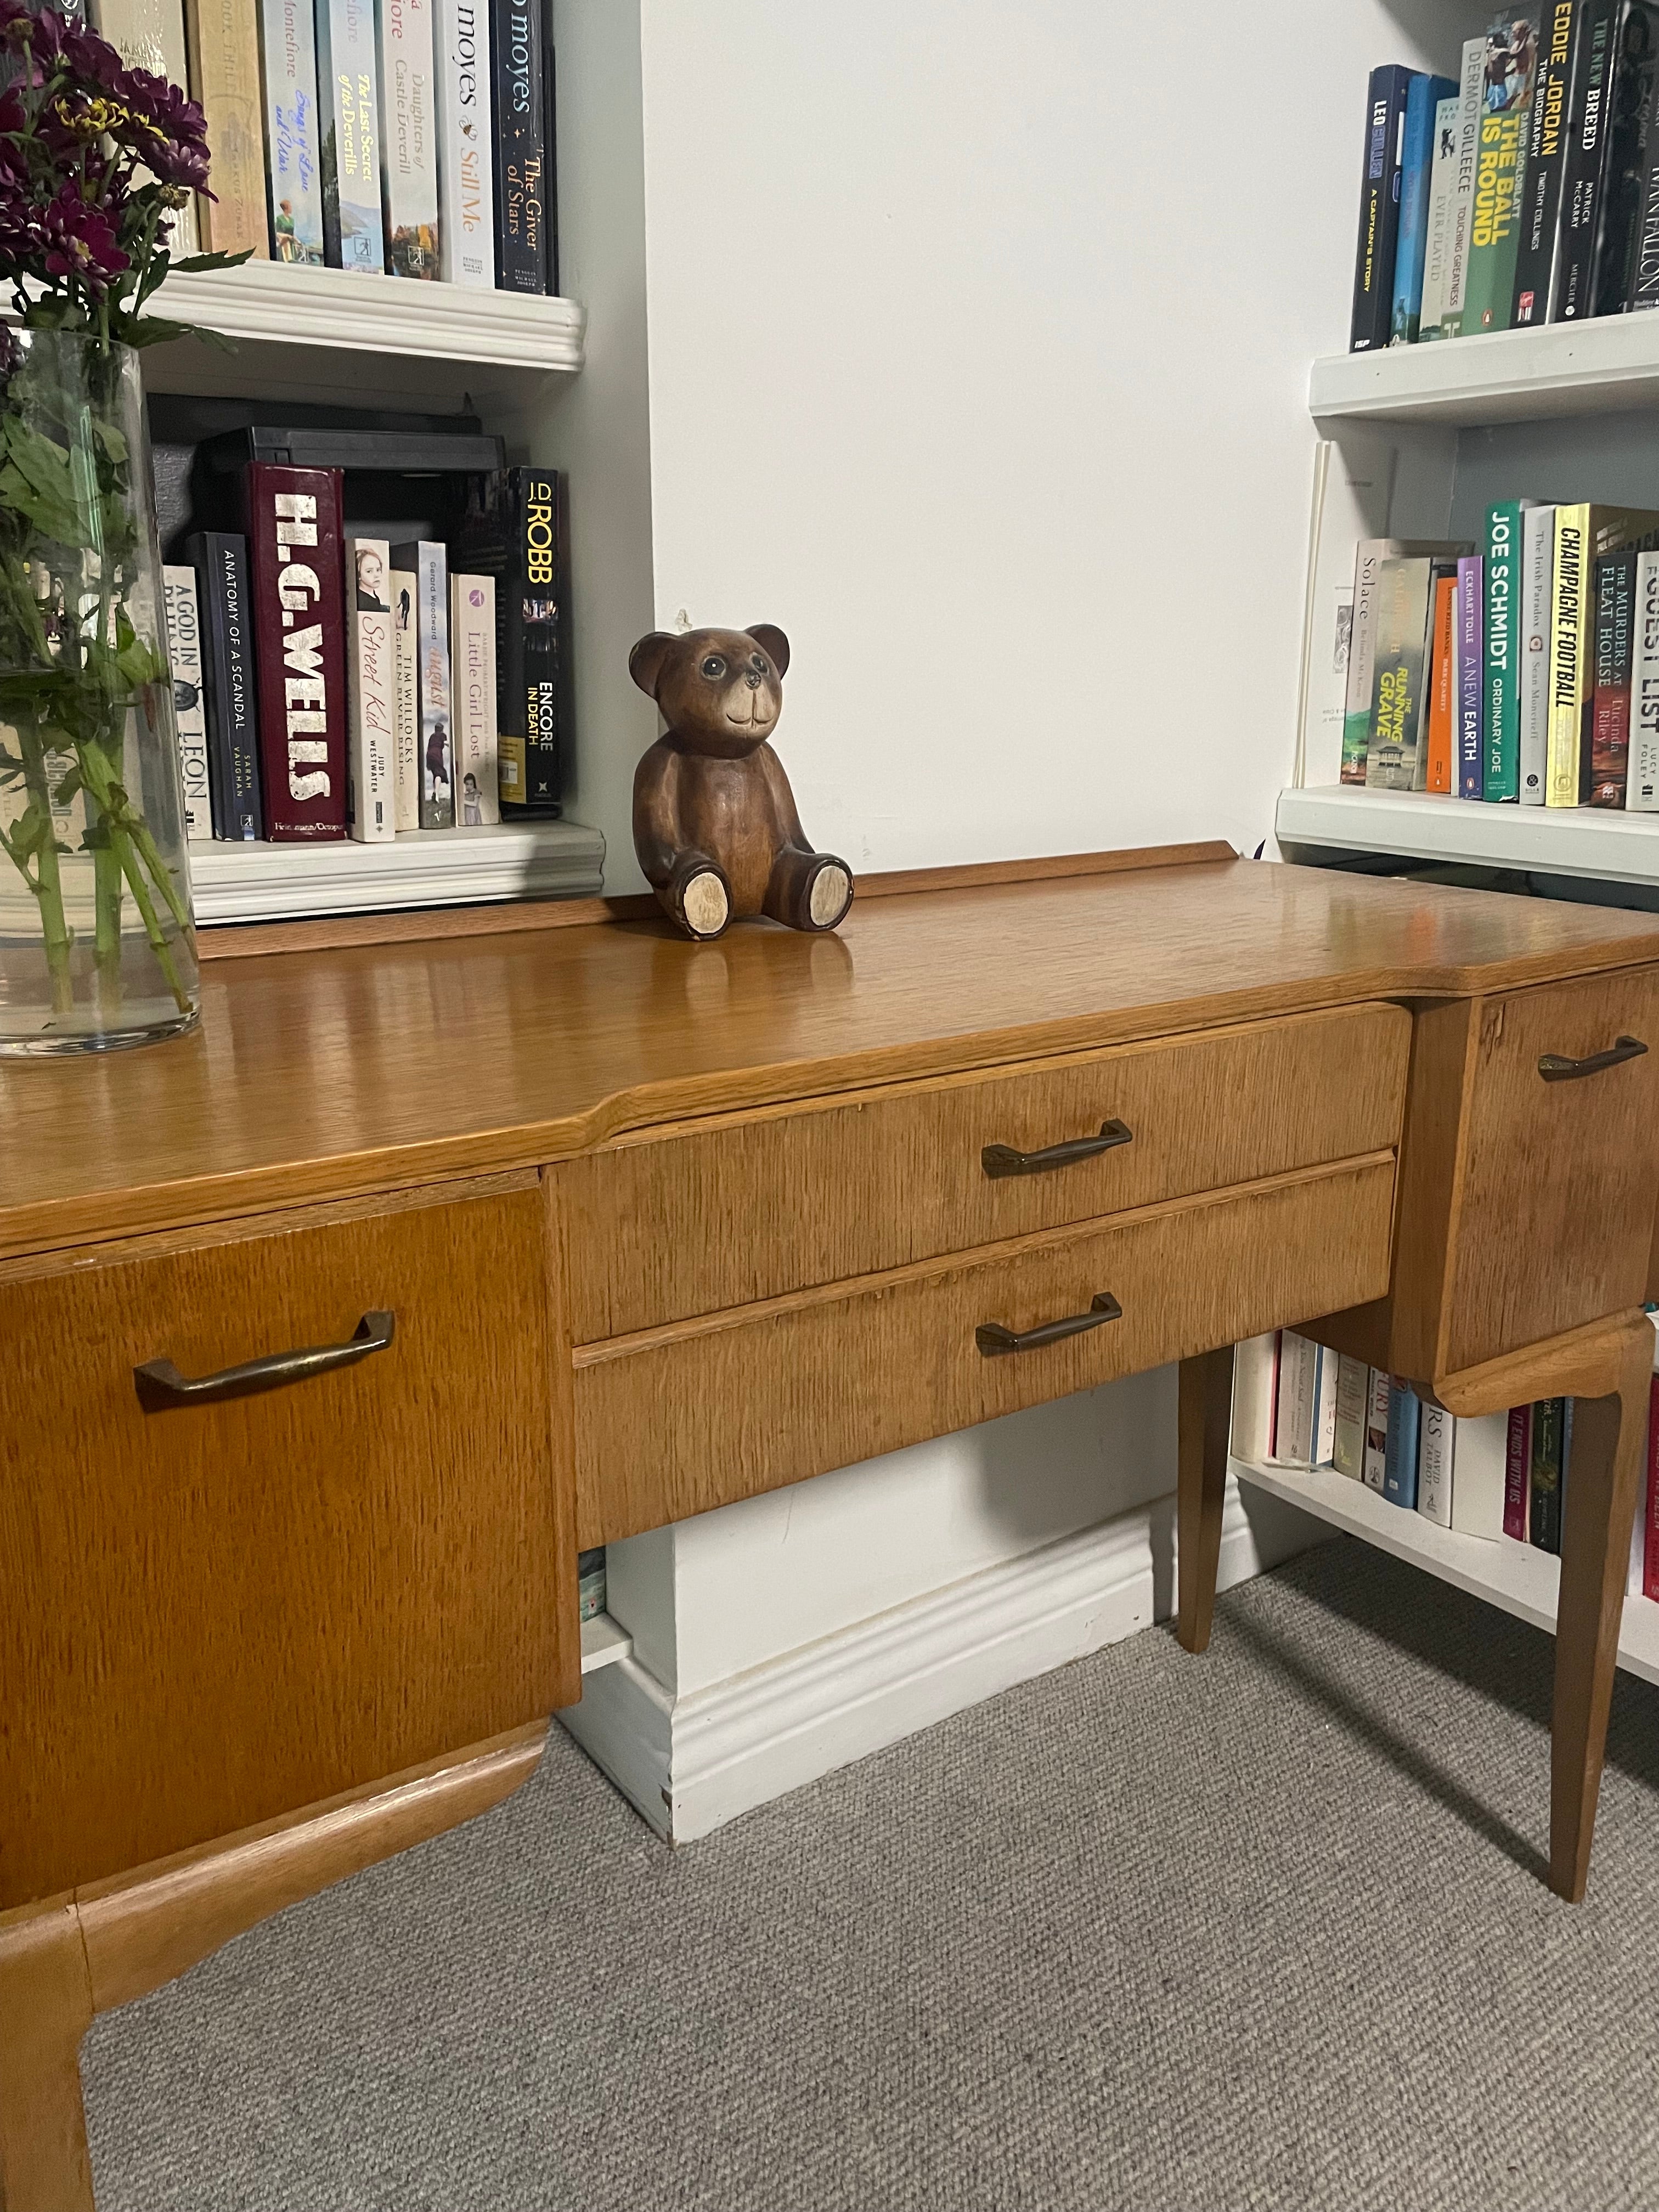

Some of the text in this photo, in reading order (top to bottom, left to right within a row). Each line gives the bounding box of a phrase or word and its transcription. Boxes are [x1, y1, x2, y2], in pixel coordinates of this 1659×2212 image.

[452, 4, 476, 106] moyes
[506, 13, 530, 113] moyes
[1542, 2, 1572, 156] EDDIE JORDAN
[1582, 19, 1608, 150] THE NEW BREED
[275, 105, 291, 174] and War
[337, 74, 358, 175] of the Deverills
[357, 74, 374, 181] The Last Secret
[395, 59, 410, 173] Castle Deverill
[410, 73, 425, 171] Daughters of
[1369, 100, 1387, 179] LEO CULLEN
[1458, 52, 1481, 193] DERMOT GILLEECE
[1530, 59, 1548, 157] THE BIOGRAPHY
[300, 153, 314, 192] Love
[461, 148, 481, 233] Still Me
[507, 165, 524, 236] of Stars
[524, 157, 542, 251] The Giver
[1371, 189, 1378, 198] A
[1472, 117, 1502, 246] IS ROUND
[1491, 113, 1520, 245] THE BALL
[1510, 112, 1529, 218] DAVID GOLDBLATT
[1570, 181, 1583, 228] McCARRY
[1581, 182, 1594, 224] PATRICK
[1431, 196, 1445, 281] EVER PLAYED
[1454, 206, 1467, 253] TOUCHING
[1531, 170, 1547, 250] TIMOTHY COLLINGS
[1449, 255, 1463, 306] GREATNESS
[1354, 339, 1370, 348] ISP
[528, 504, 552, 583] ROBB
[1533, 531, 1544, 628] The Irish Paradox
[1558, 527, 1580, 628] CHAMPAGNE
[175, 584, 198, 666] A GOD IN
[1359, 558, 1375, 620] Solace
[1465, 571, 1474, 644] ECKHART TOLLE
[1489, 511, 1510, 670] JOE SCHMIDT
[1598, 567, 1615, 687] FLEAT HOUSE
[1613, 565, 1628, 686] THE MURDERS AT
[224, 550, 245, 730] ANATOMY OF A SCANDAL
[362, 616, 391, 735] Street Kid
[426, 646, 447, 708] august
[1556, 630, 1576, 708] FOOTBALL
[404, 656, 414, 764] TIM WILLOCKS
[468, 632, 483, 759] Little Girl Lost
[528, 687, 538, 746] IN DEATH
[539, 682, 553, 752] ENCORE
[1377, 672, 1395, 739] GRAVE
[1391, 667, 1409, 743] RUNNING
[1404, 697, 1412, 714] THE
[1463, 657, 1477, 761] A NEW EARTH
[1492, 679, 1502, 745] ORDINARY
[1530, 661, 1541, 740] Sean Moncrieff
[1595, 710, 1610, 744] Riley
[1610, 699, 1623, 752] Lucinda
[1640, 679, 1659, 733] LIST
[182, 732, 206, 798] LEON
[234, 747, 244, 797] VAUGHAN
[244, 755, 252, 789] SARAH
[370, 740, 379, 793] WESTWATER
[1492, 749, 1501, 772] JOE
[1640, 743, 1649, 779] FOLEY
[1650, 747, 1658, 775] LUCY
[1427, 1406, 1443, 1438] RS
[1509, 1413, 1524, 1505] IT ENDS WITH US
[1434, 1449, 1442, 1484] DAVID
